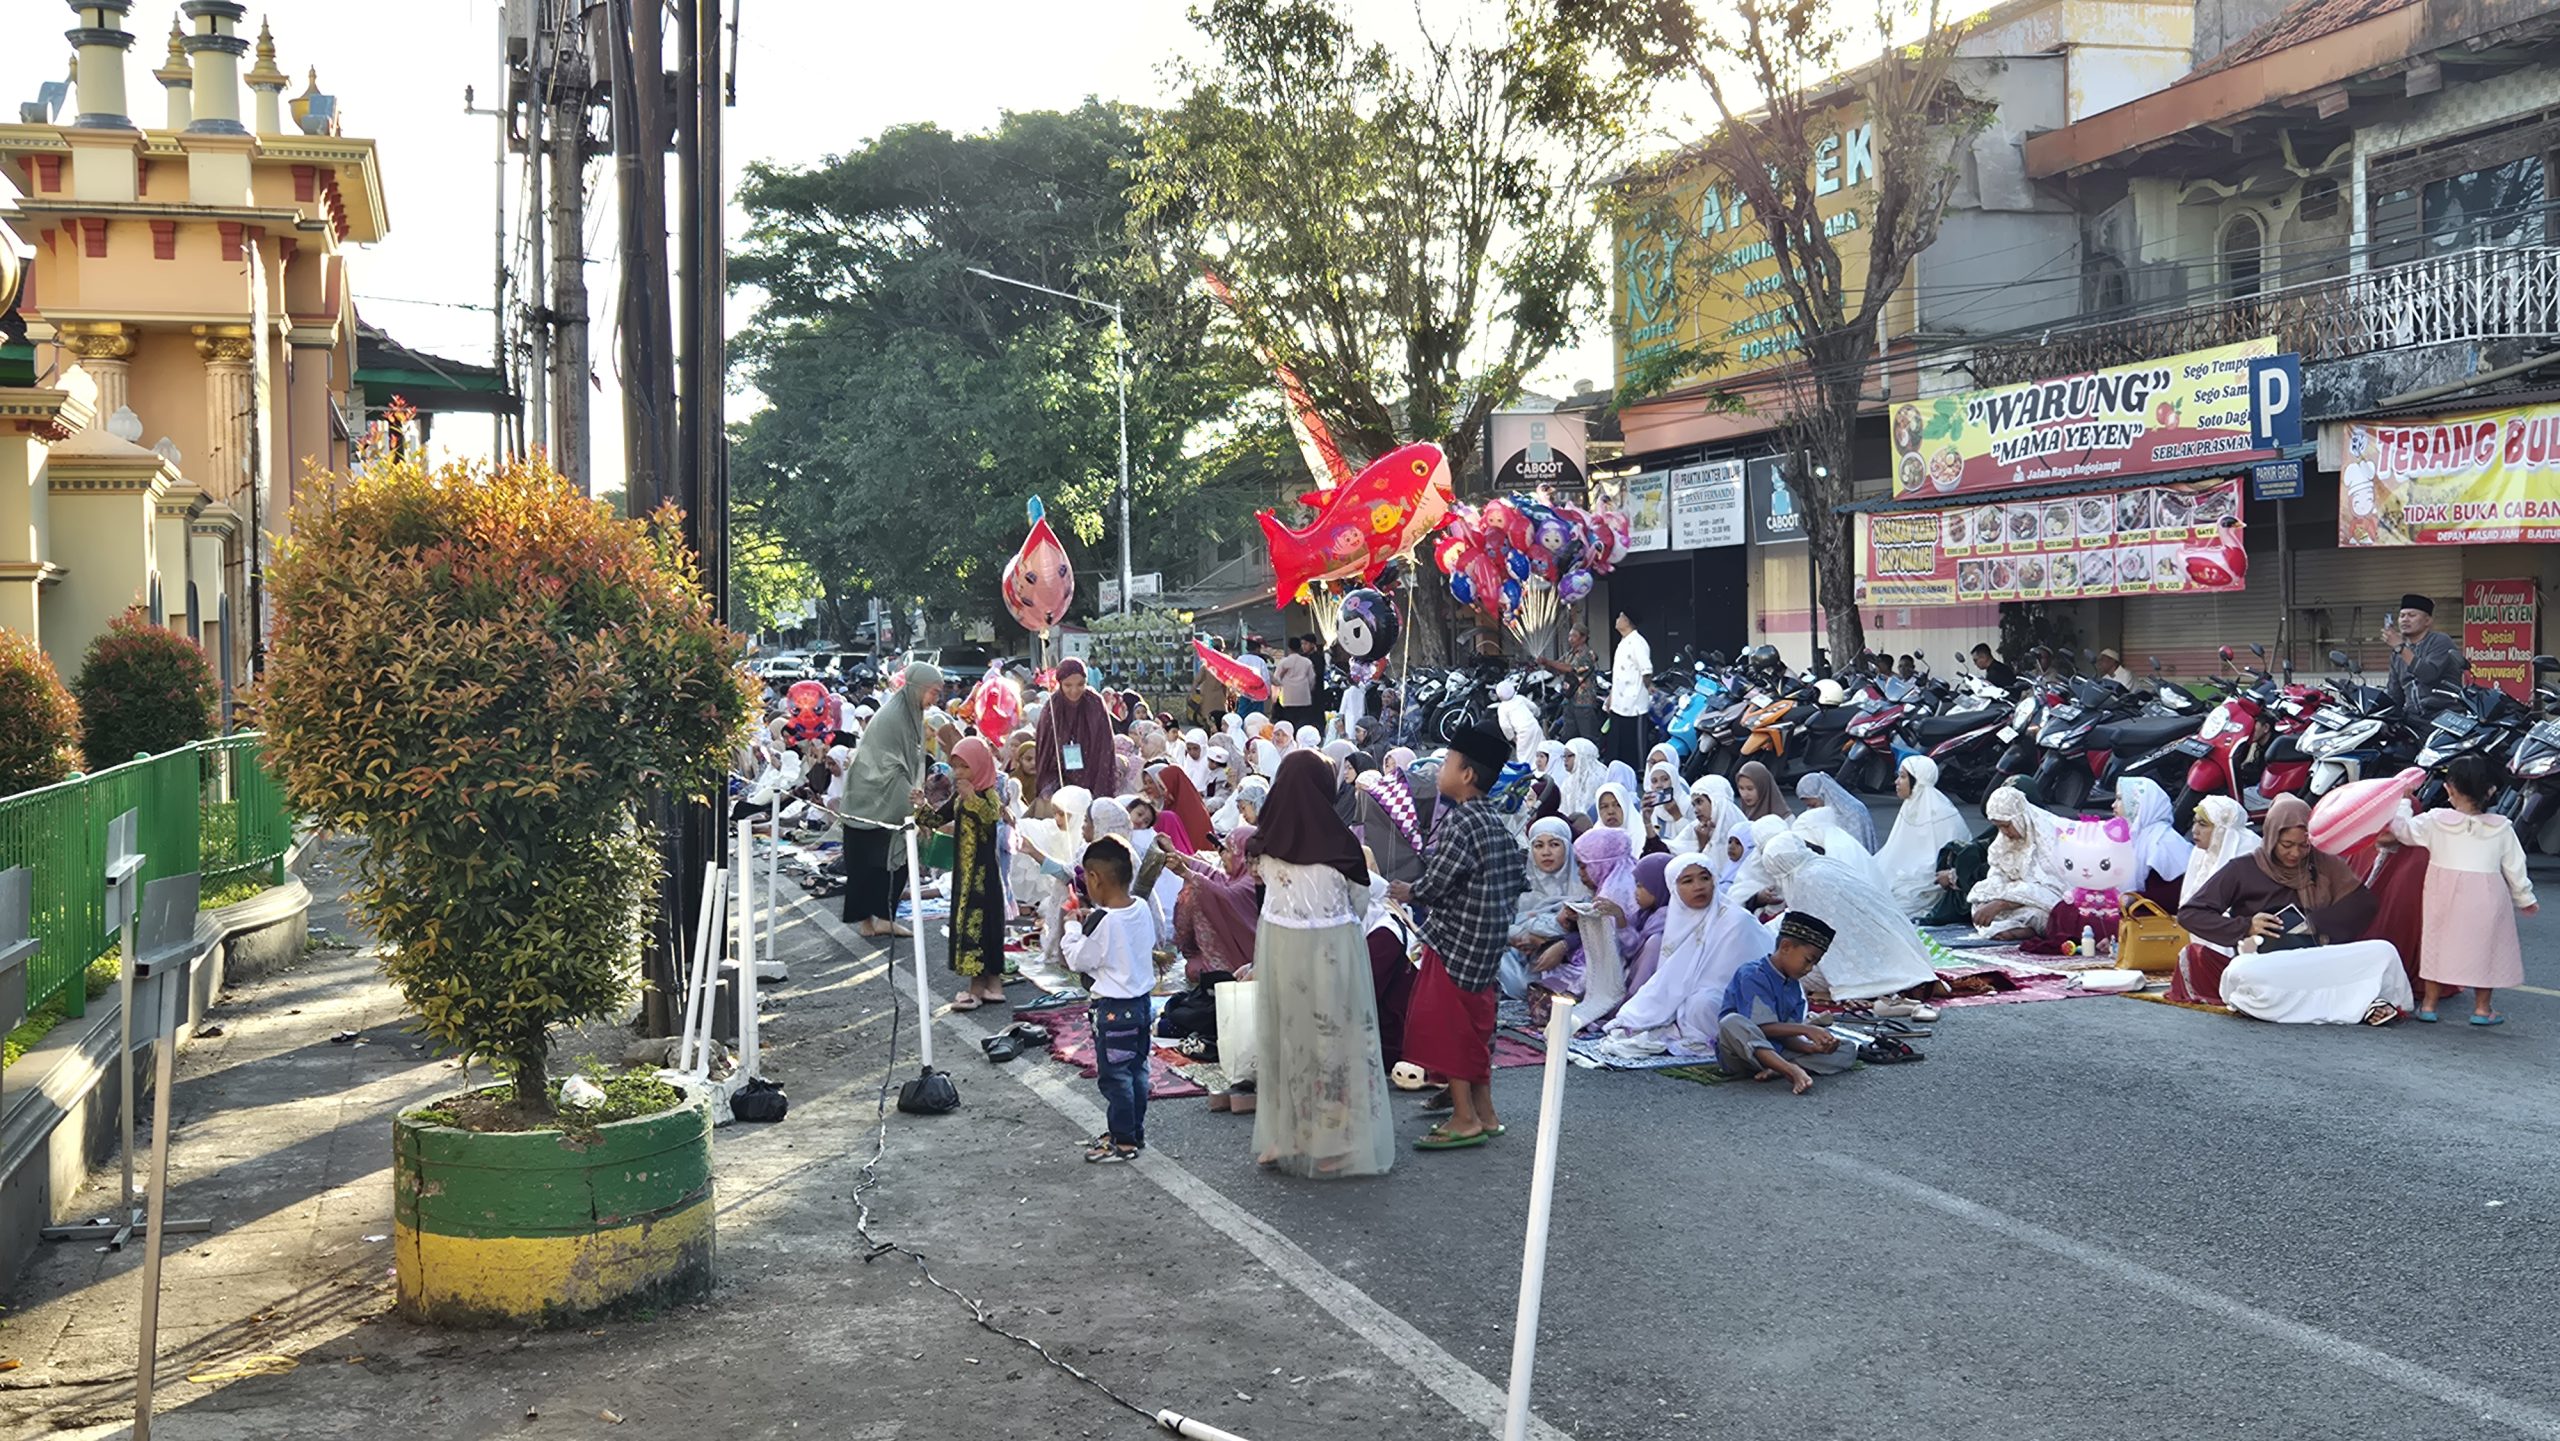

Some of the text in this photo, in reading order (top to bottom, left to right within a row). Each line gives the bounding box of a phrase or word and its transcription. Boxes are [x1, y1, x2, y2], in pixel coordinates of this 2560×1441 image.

[2183, 363, 2209, 381] Sego
[2194, 385, 2249, 405] Sego Sam
[2259, 367, 2290, 439] P
[2198, 414, 2223, 429] Soto
[2152, 443, 2195, 460] SEBLAK
[2378, 422, 2497, 474] TERANG
[1515, 462, 1564, 475] CABOOT
[2027, 458, 2122, 480] Jalan Raya Rogojampi
[2256, 463, 2299, 481] PARKIR GRATIS
[2403, 504, 2448, 523] TIDAK
[2453, 501, 2498, 521] BUKA
[1766, 513, 1799, 530] CABOOT
[2437, 531, 2466, 541] DEPAN
[2467, 529, 2500, 541] MASJID
[2474, 584, 2525, 607] Warung
[2465, 604, 2533, 623] MAMA YEYEN
[2481, 629, 2515, 647] Spesial
[2465, 646, 2532, 661] Masakan Khas
